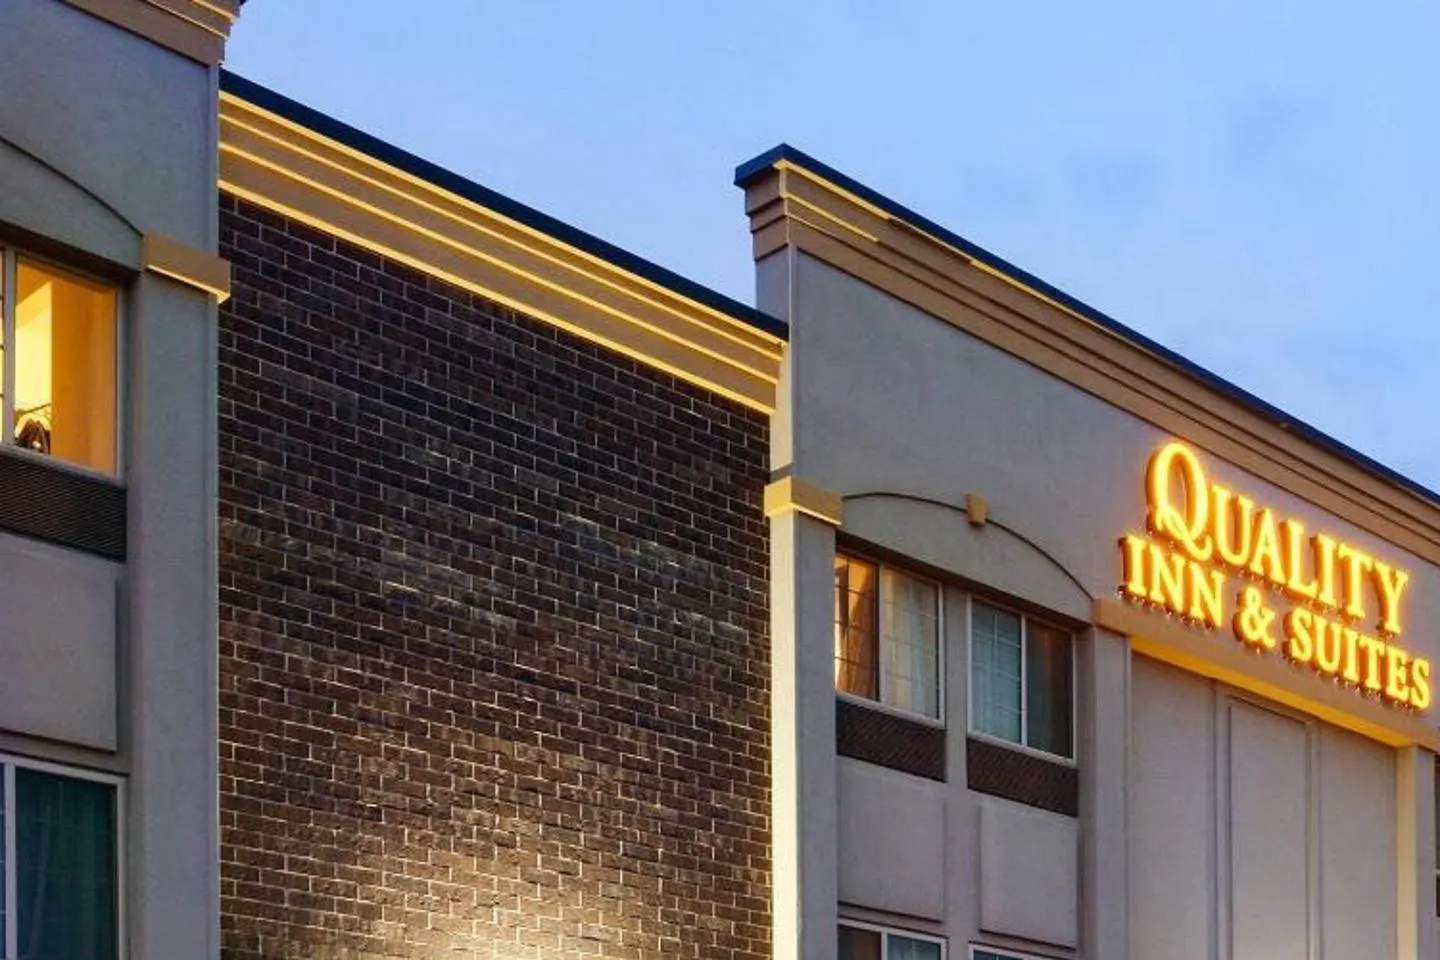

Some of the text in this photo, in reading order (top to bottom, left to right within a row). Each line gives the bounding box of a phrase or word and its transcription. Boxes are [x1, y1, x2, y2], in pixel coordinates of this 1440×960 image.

[1121, 534, 1431, 711] INN & SUITES
[1149, 441, 1409, 635] QUALITY
